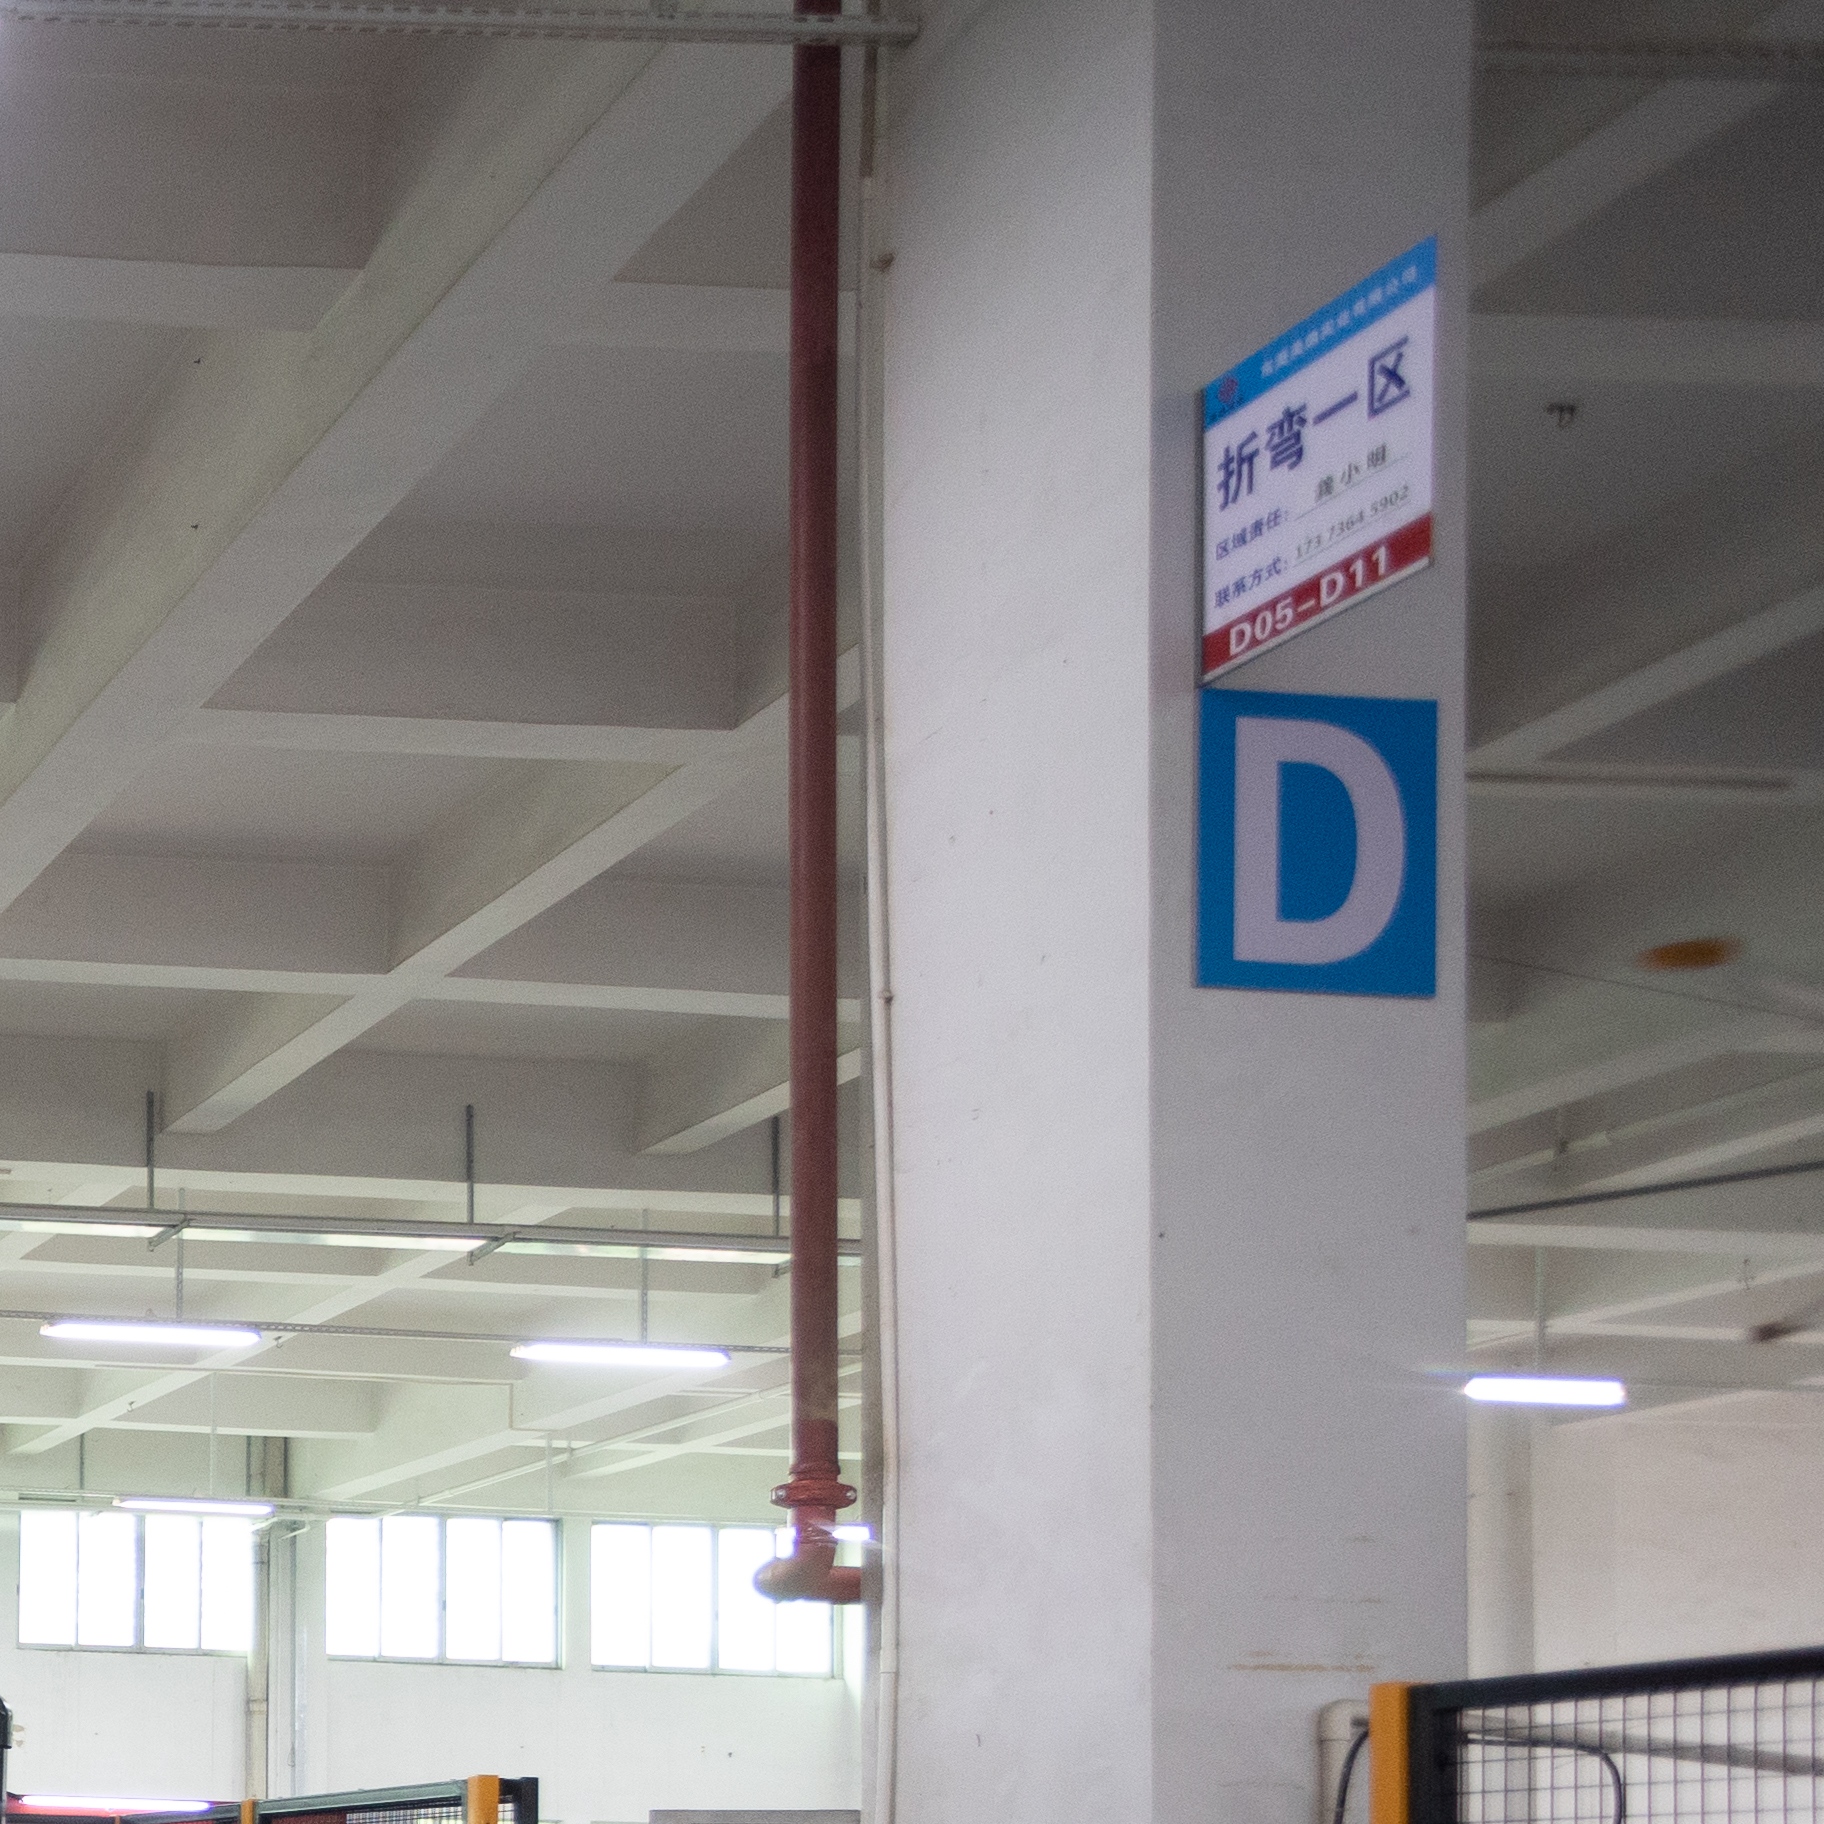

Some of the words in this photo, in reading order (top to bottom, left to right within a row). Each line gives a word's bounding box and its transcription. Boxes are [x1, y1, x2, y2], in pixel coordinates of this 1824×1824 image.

[1216, 334, 1411, 513] 折弯一区
[1229, 544, 1389, 657] D05-D11
[1233, 716, 1407, 966] D
